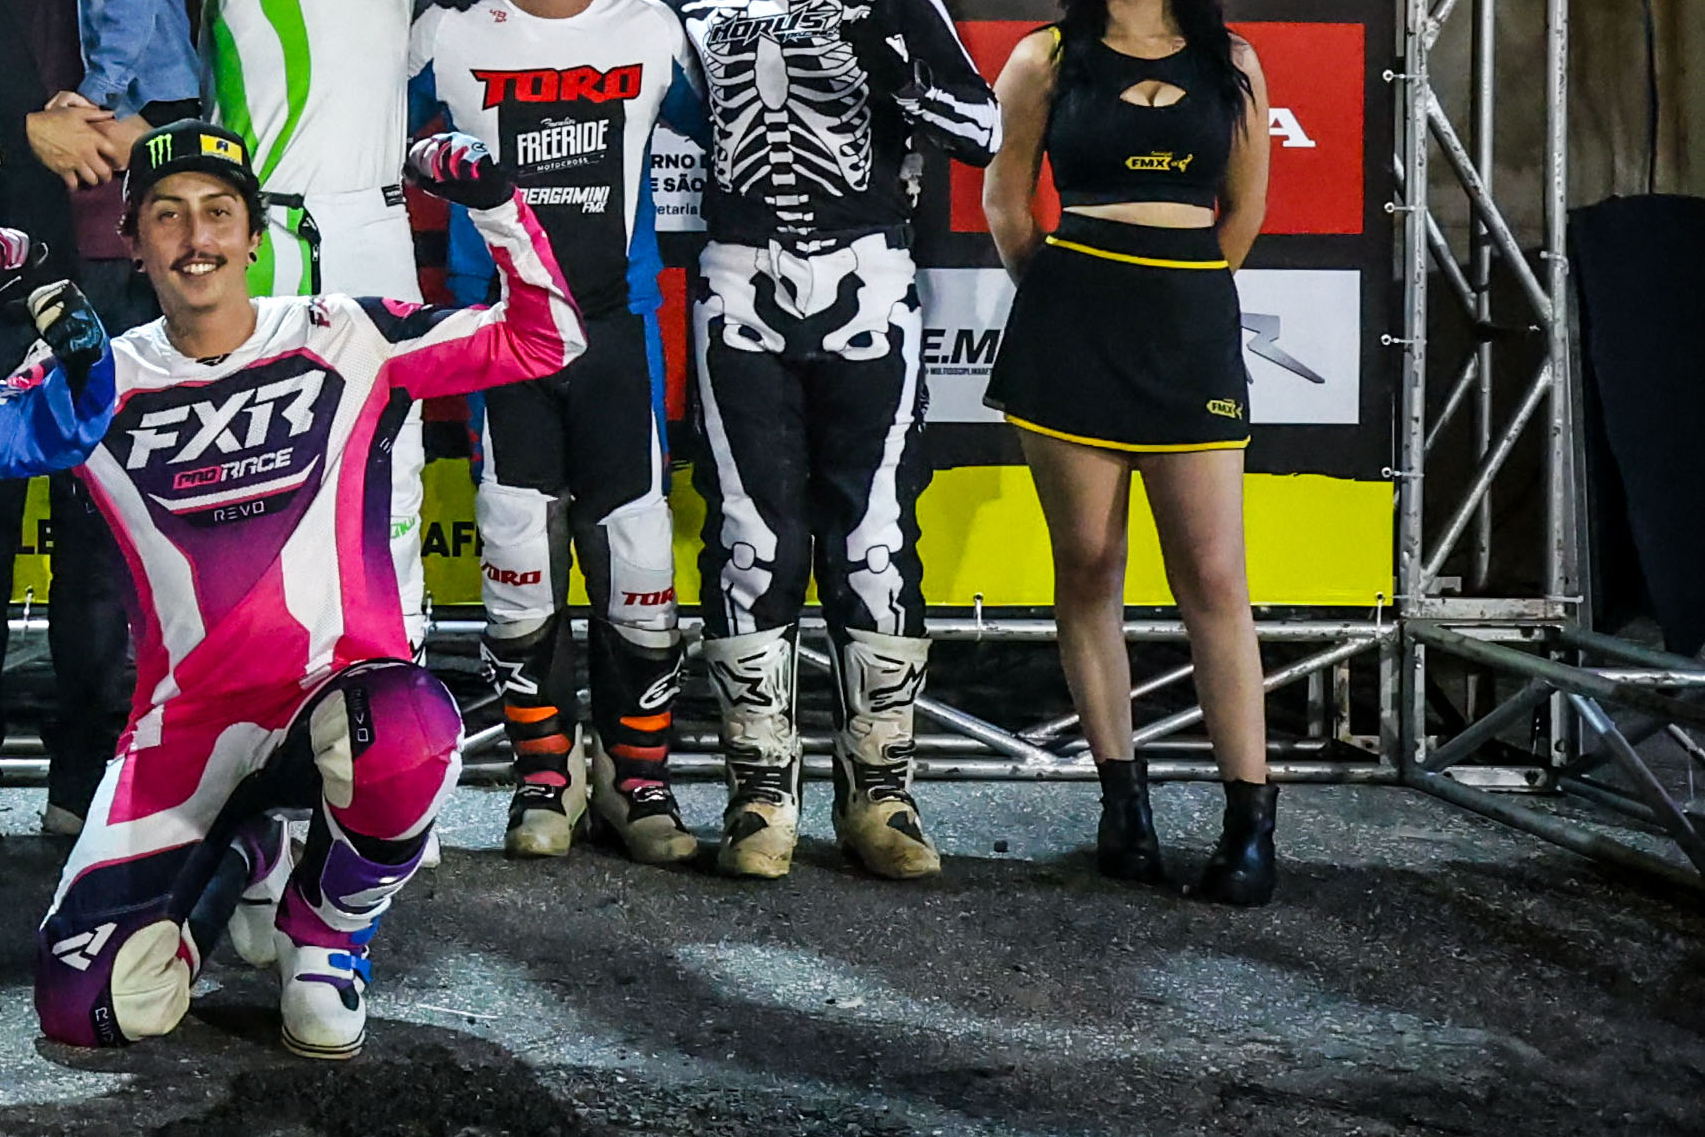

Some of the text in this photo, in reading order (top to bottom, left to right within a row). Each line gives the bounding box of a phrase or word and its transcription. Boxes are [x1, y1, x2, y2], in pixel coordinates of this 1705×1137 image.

[470, 63, 644, 110] TORO
[517, 119, 610, 166] FREERIDE
[1132, 158, 1166, 167] FMX
[582, 201, 607, 213] FMX
[126, 369, 328, 470] FXR
[213, 500, 265, 522] REVO
[621, 586, 674, 605] TOR
